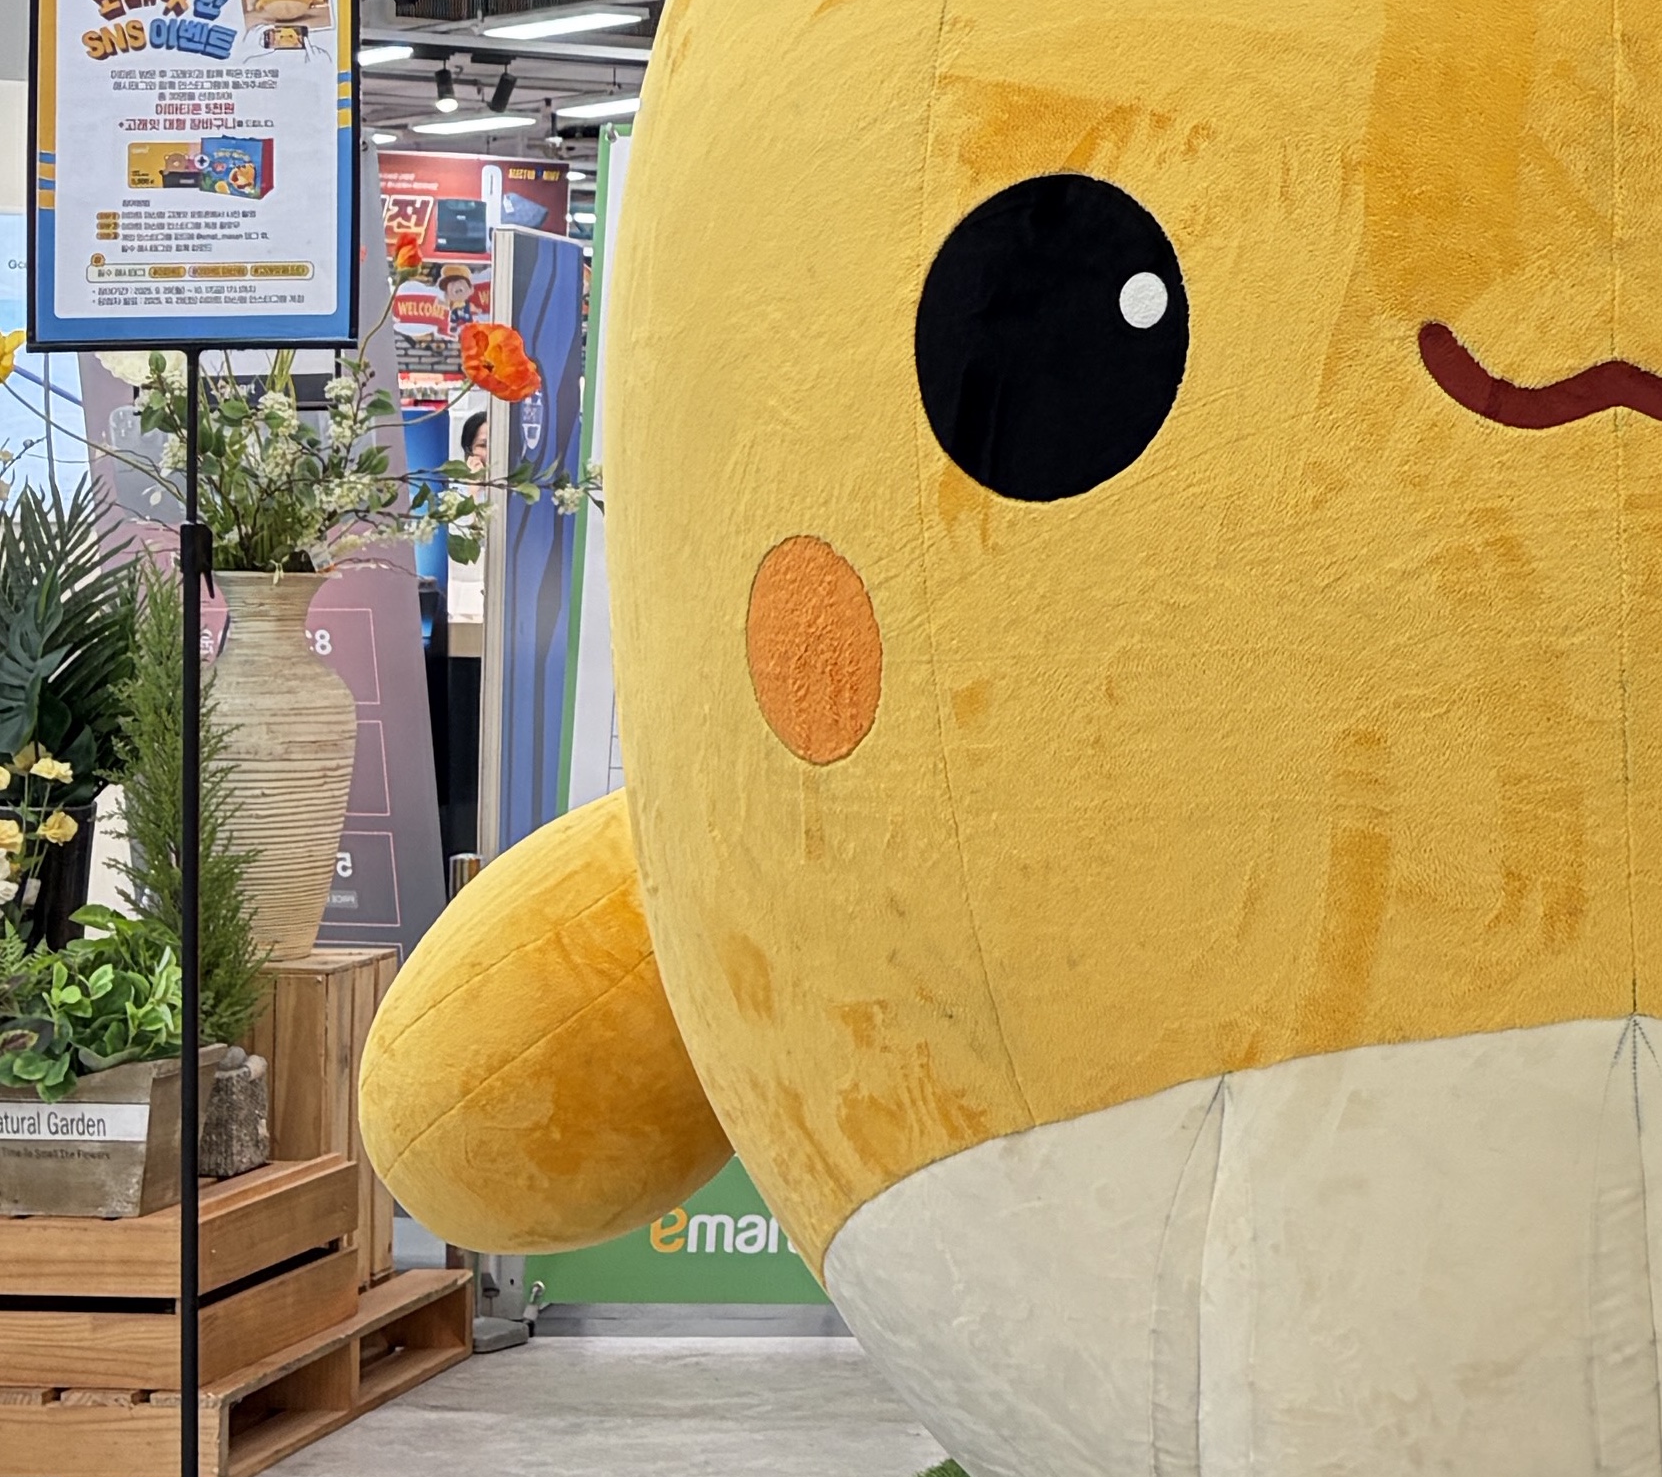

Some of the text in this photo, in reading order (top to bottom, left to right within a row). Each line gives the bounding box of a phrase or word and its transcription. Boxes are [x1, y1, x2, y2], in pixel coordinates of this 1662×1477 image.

[81, 18, 238, 61] SNS 이벤트
[397, 301, 446, 320] WELCOME
[47, 1110, 107, 1137] Garden
[650, 1207, 798, 1254] emar
